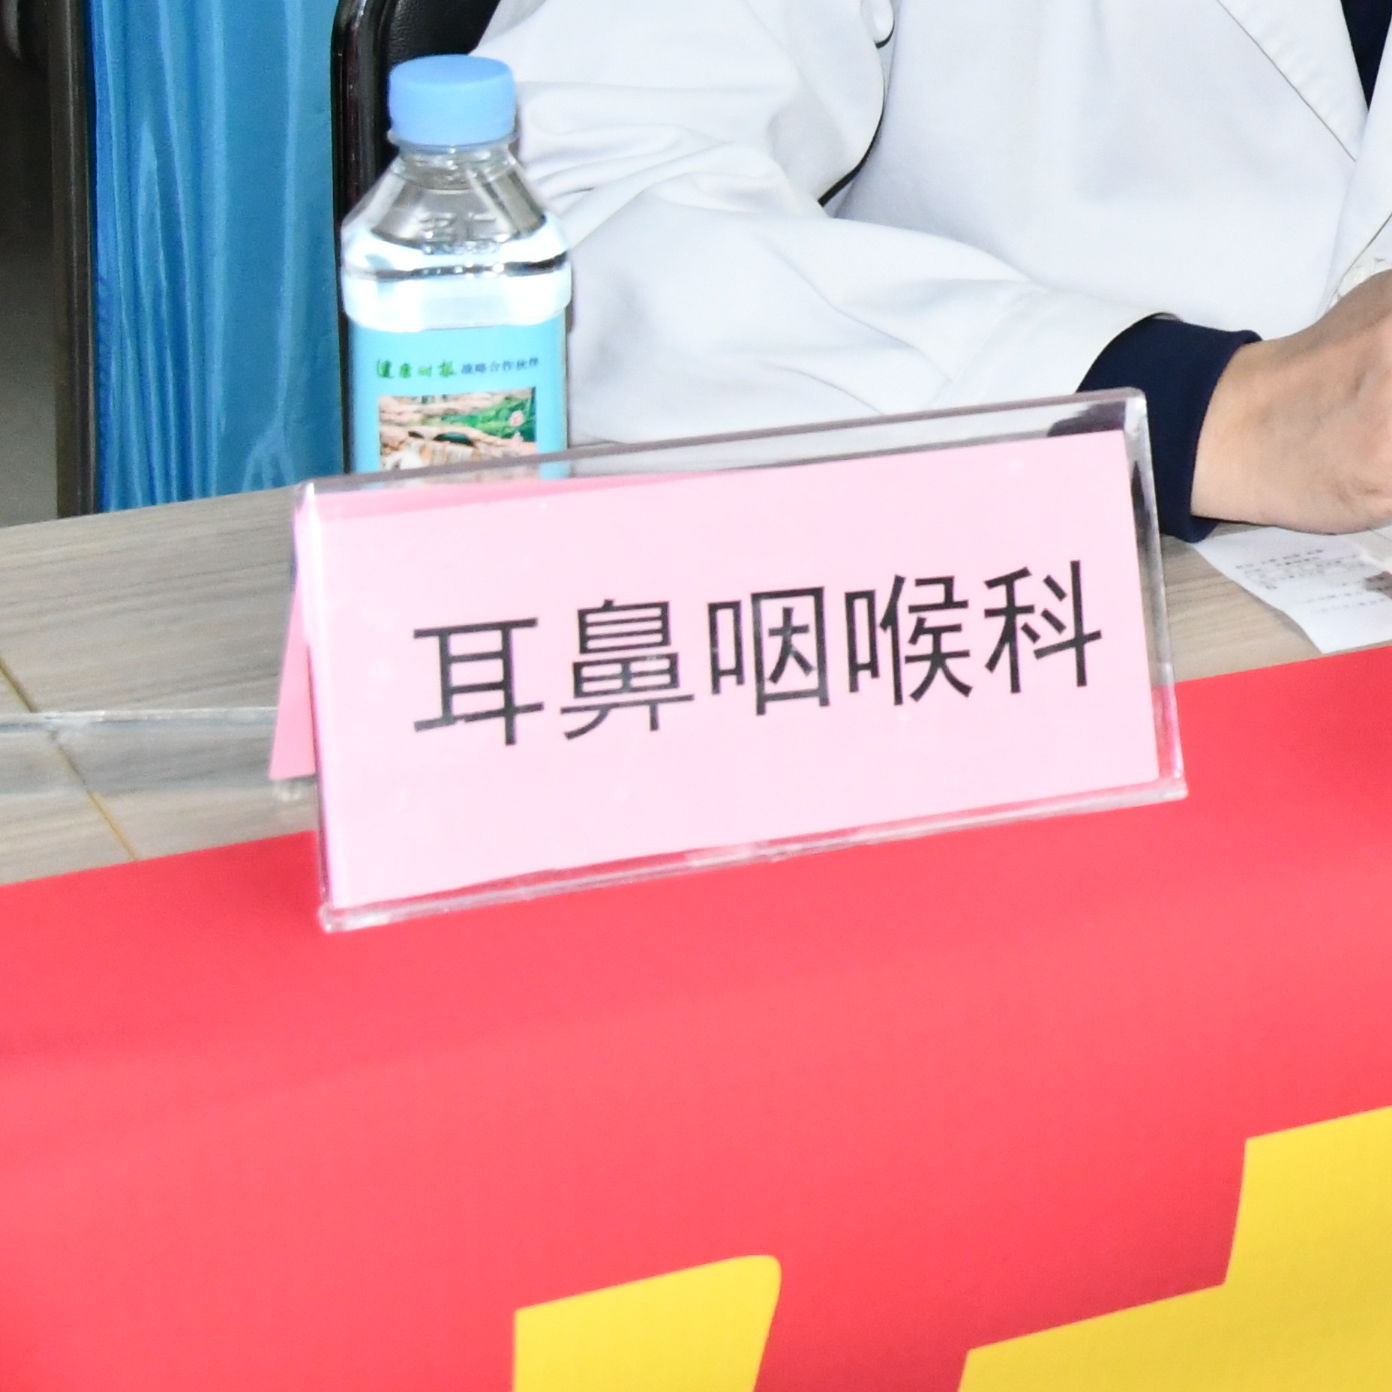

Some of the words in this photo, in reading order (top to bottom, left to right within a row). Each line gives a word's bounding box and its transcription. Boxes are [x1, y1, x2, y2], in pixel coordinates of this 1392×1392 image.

[412, 560, 1102, 746] 耳鼻咽喉科
